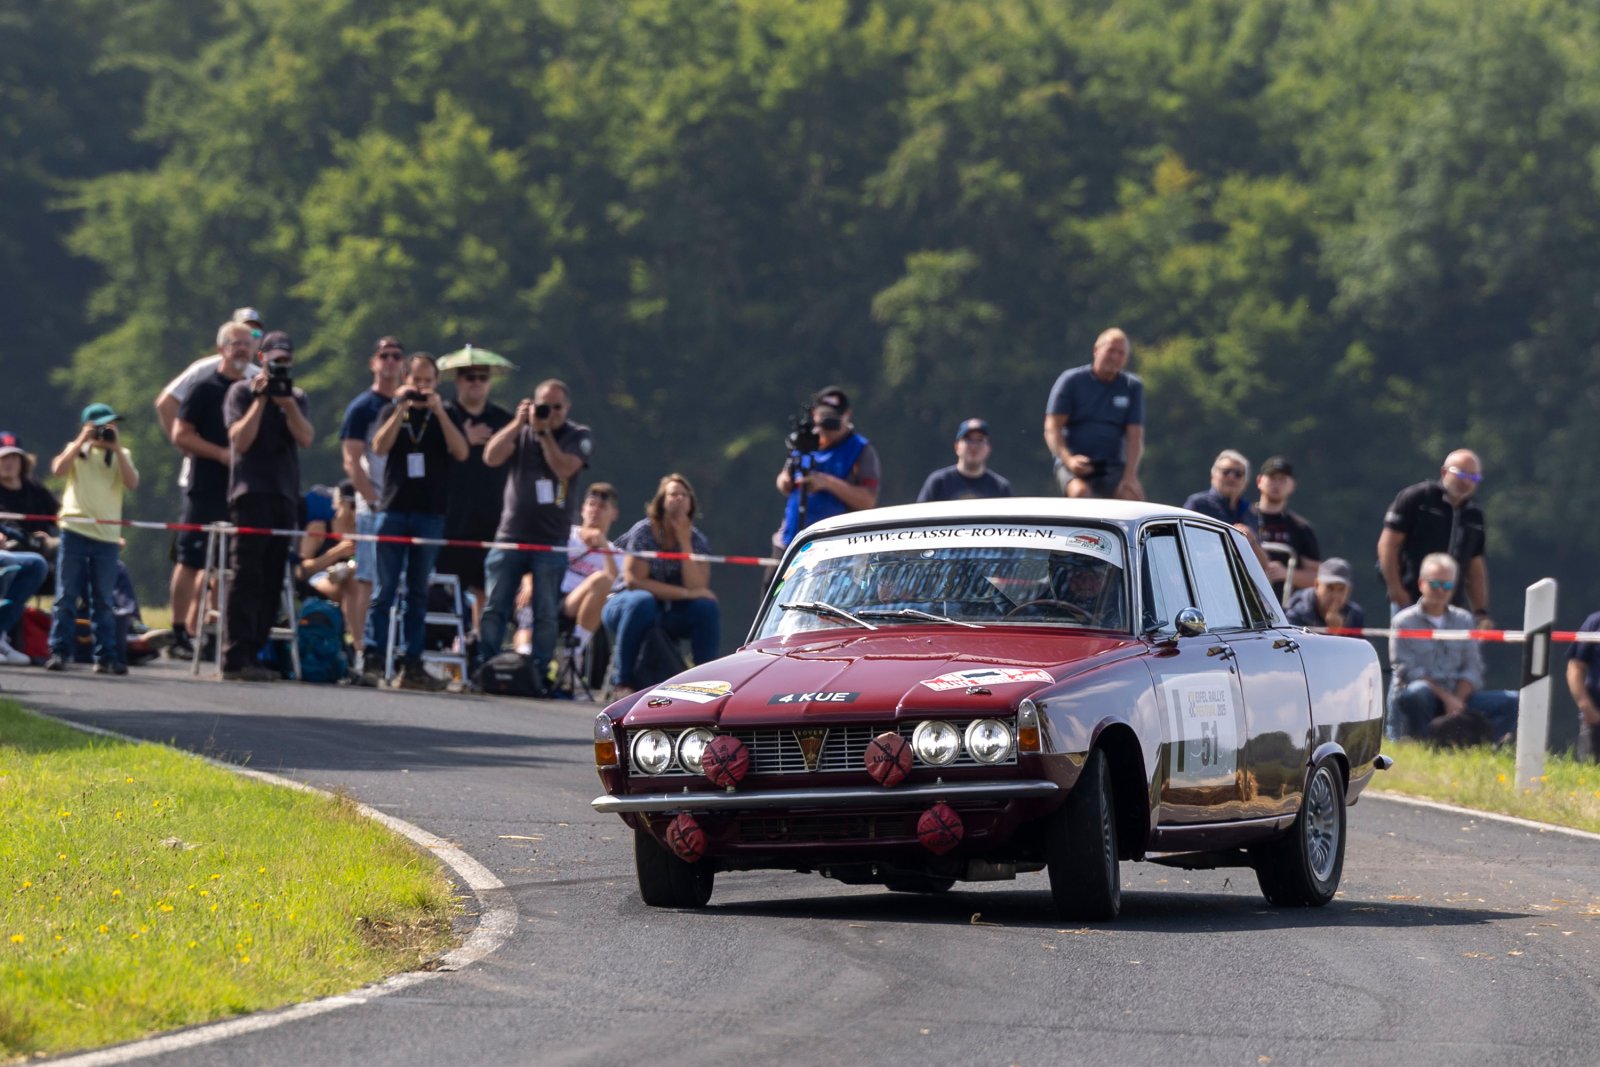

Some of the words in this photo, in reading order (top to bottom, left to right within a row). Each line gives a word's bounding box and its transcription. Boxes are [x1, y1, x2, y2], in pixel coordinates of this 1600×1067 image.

[847, 527, 1057, 545] WWW.CLASSIC-ROVER.NL
[778, 693, 793, 704] 4
[799, 691, 850, 702] KUE
[1200, 720, 1218, 767] 51
